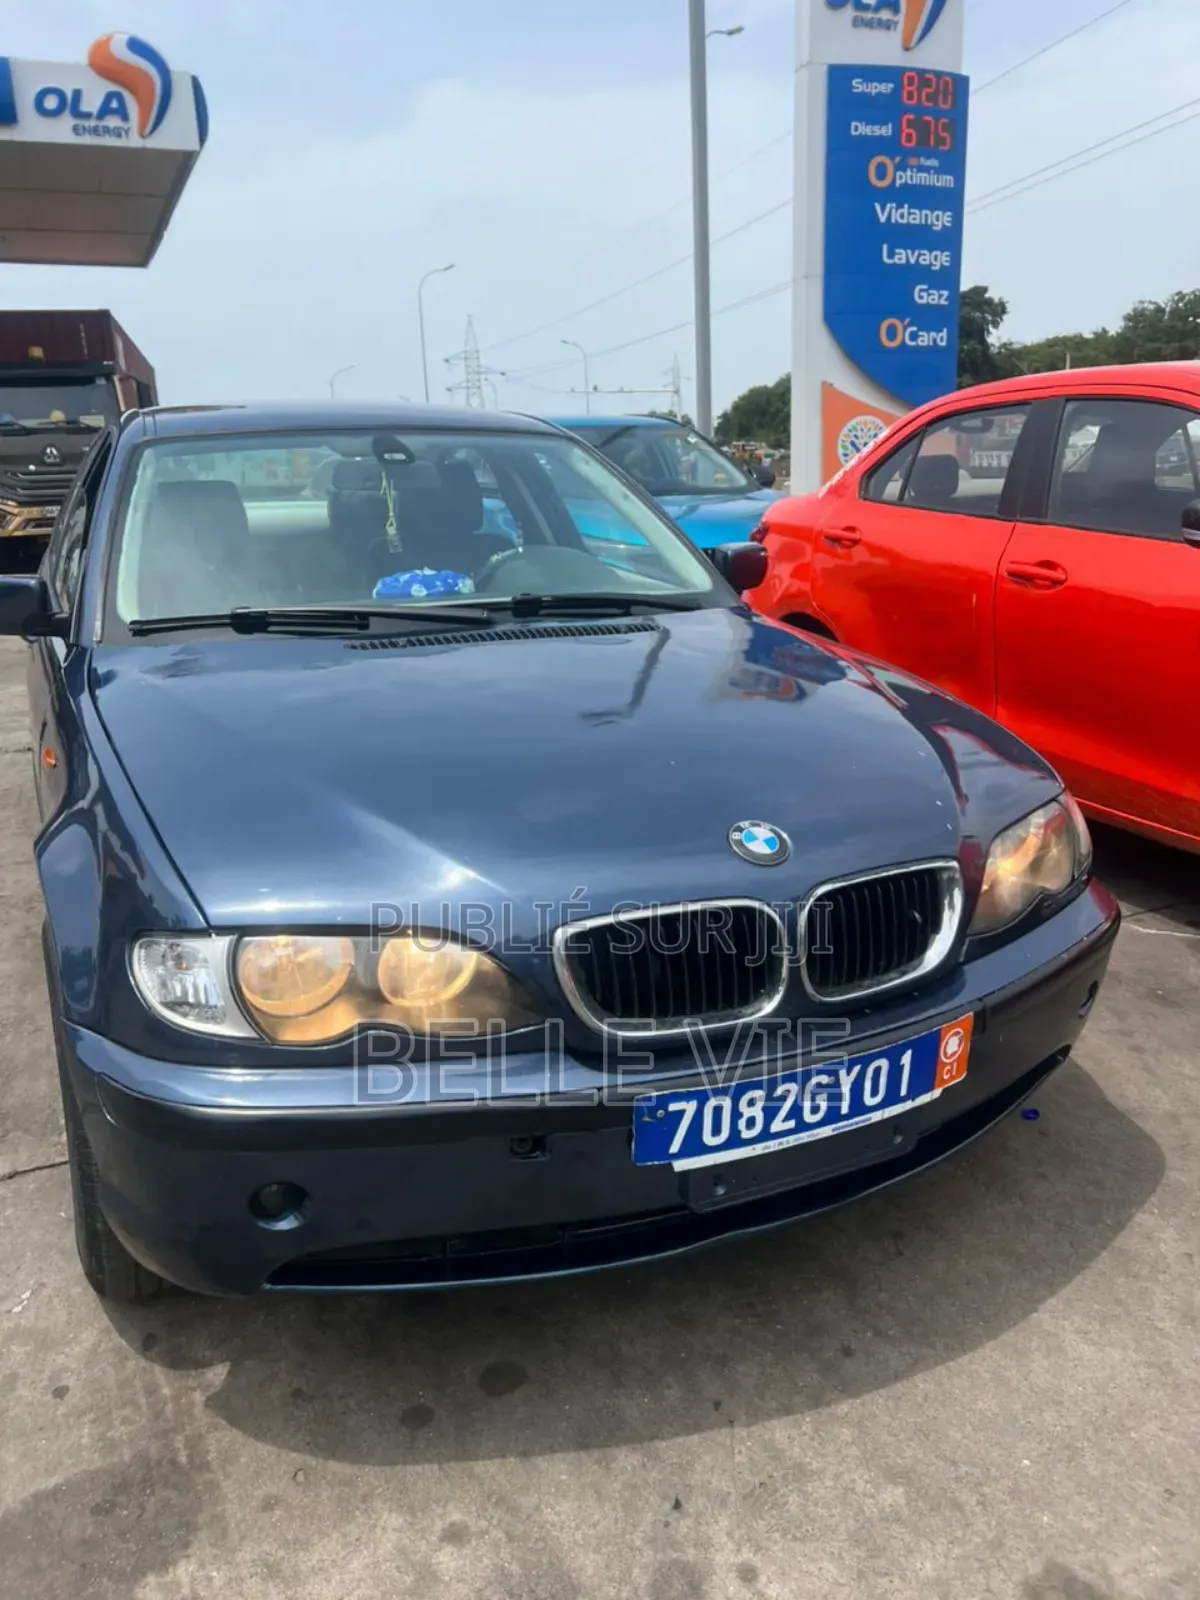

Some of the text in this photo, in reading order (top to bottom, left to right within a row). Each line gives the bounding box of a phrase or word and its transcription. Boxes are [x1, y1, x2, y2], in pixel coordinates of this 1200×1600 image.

[852, 15, 900, 31] ENERGY
[34, 86, 130, 122] OLA
[852, 72, 953, 109] Super 820
[72, 123, 131, 139] ENERGY
[851, 114, 952, 151] Diesel 675
[874, 202, 952, 230] Vidange
[882, 244, 951, 270] Lavage
[914, 285, 949, 305] Gaz
[667, 1049, 913, 1154] 7082GY01
